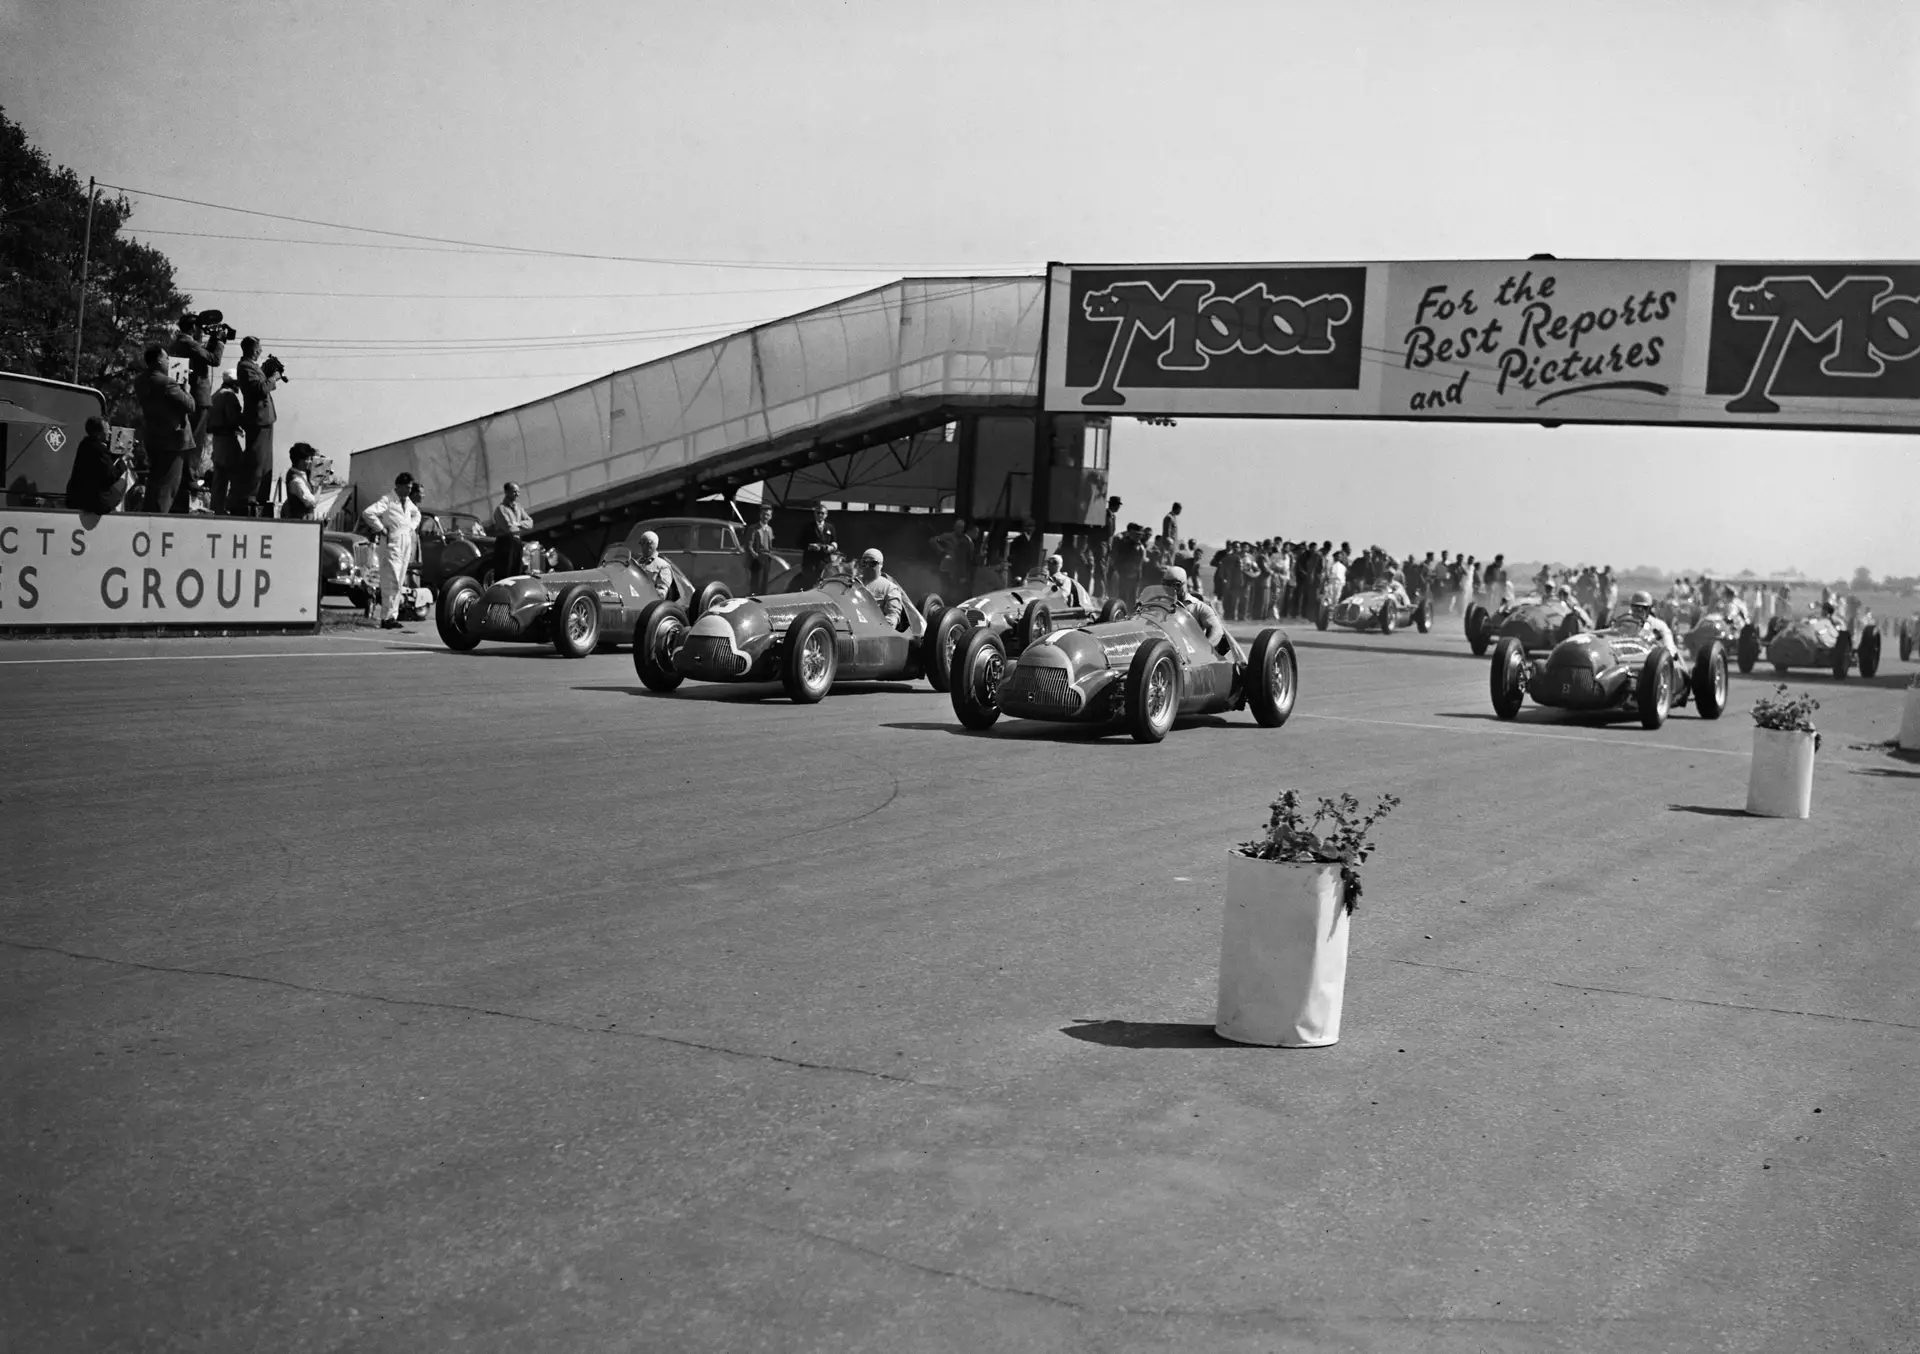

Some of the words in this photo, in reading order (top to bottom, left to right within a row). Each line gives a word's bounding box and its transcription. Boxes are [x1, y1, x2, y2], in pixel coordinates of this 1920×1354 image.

[1404, 318, 1502, 369] Best
[1518, 291, 1677, 348] Reports
[1415, 285, 1478, 325] For
[1494, 270, 1556, 305] the
[1080, 279, 1352, 406] Motor
[1410, 370, 1470, 410] and
[1497, 336, 1664, 395] Pictures
[1725, 274, 1920, 413] Mo
[0, 526, 86, 556] CTS
[132, 531, 174, 557] OF
[207, 533, 273, 559] THE
[0, 565, 39, 610] S
[100, 566, 271, 610] GROUP
